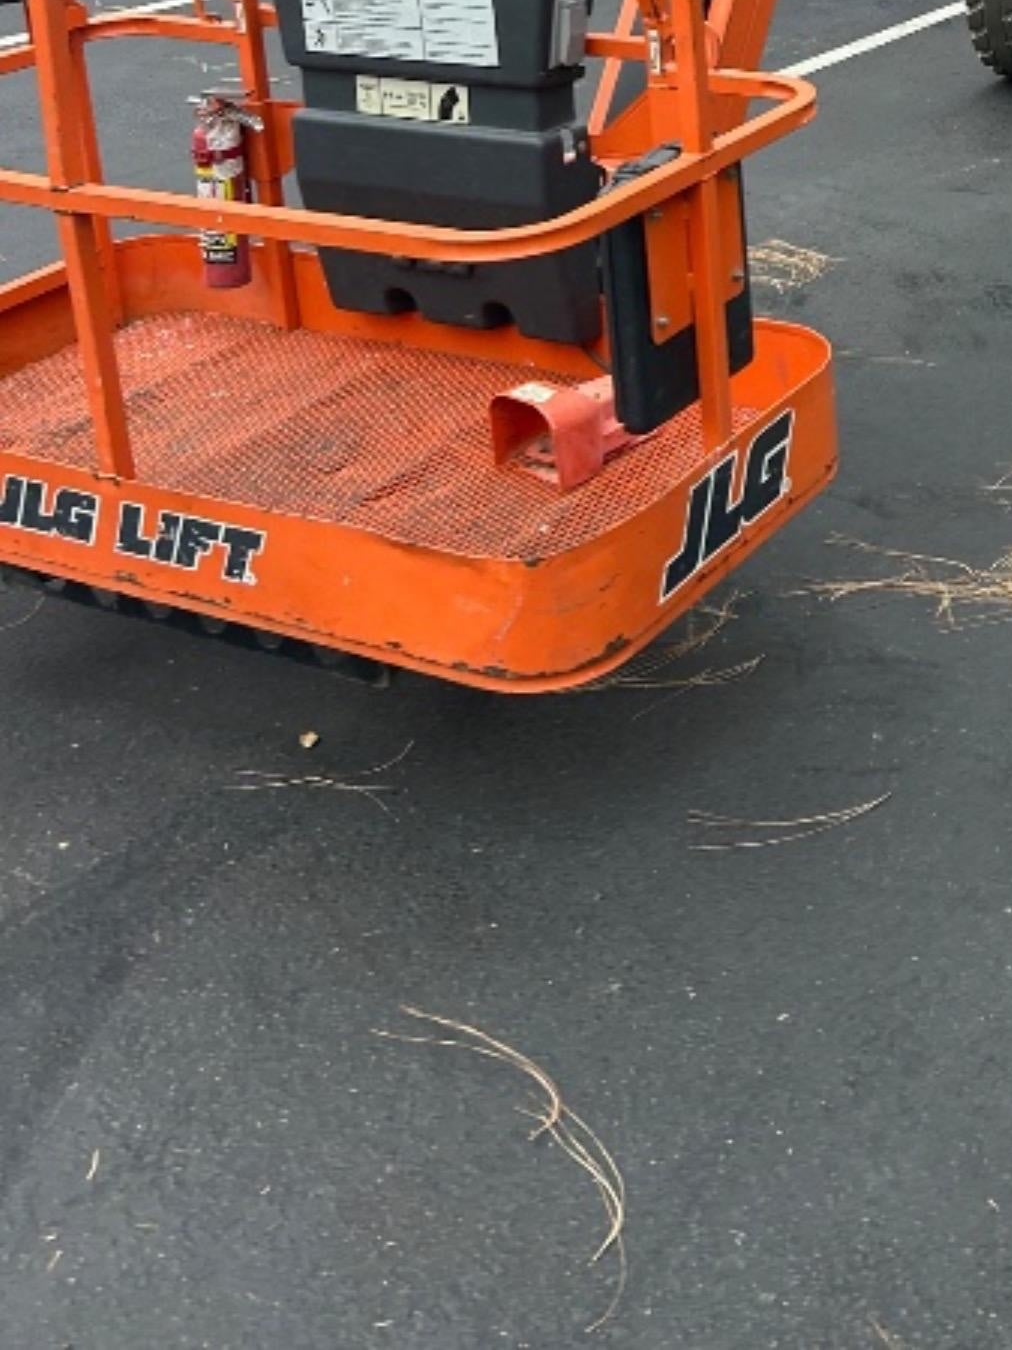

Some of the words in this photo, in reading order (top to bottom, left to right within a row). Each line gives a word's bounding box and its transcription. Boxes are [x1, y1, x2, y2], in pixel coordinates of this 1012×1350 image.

[0, 474, 101, 547] JLG
[114, 501, 267, 583] LIFT
[659, 407, 795, 605] JLG
